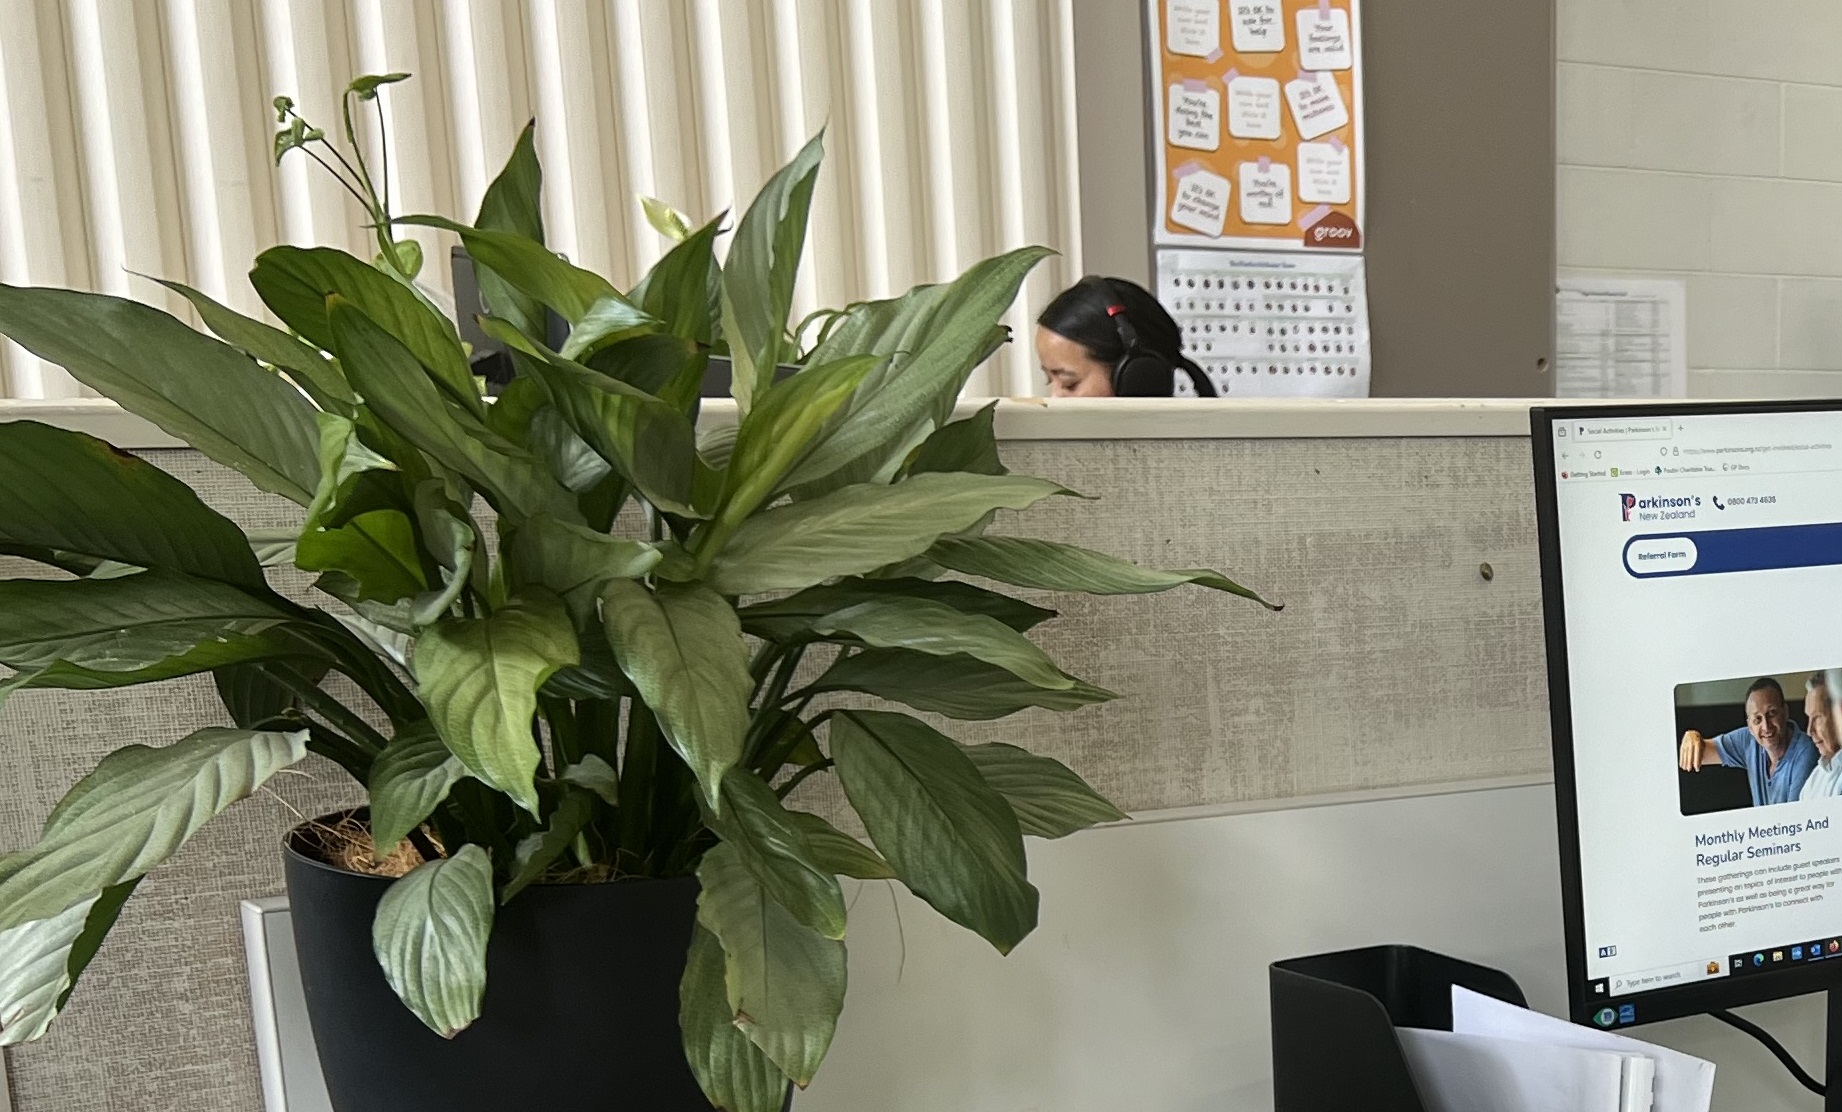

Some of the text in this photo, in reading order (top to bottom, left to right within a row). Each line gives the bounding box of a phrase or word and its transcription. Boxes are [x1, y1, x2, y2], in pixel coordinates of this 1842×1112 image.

[1314, 226, 1352, 242] groov
[1639, 509, 1695, 520] New Zealand
[1638, 551, 1666, 560] Referral
[1695, 816, 1829, 847] Monthly Meetings And
[1696, 842, 1802, 867] Regular Seminars
[1626, 977, 1640, 988] Type
[1663, 970, 1680, 980] search
